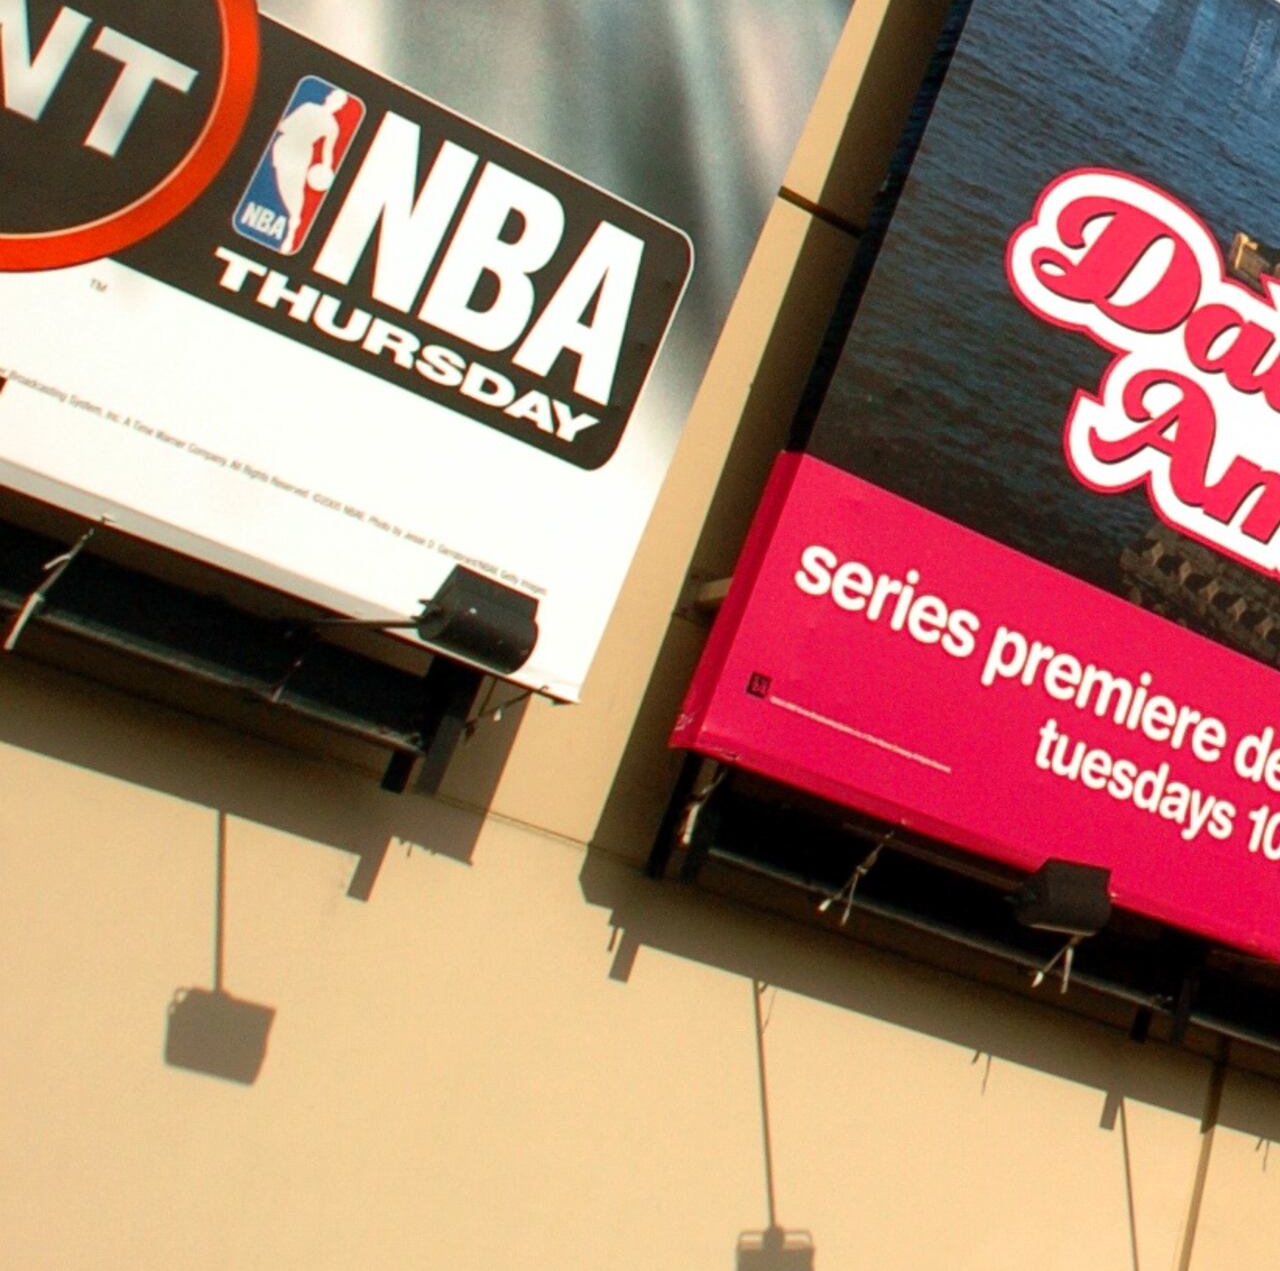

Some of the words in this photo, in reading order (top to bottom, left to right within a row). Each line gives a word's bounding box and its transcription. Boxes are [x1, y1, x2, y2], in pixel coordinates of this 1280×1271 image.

[241, 201, 287, 241] NBA
[313, 111, 645, 406] NBA
[214, 246, 599, 443] THURSDAY
[794, 544, 981, 658] series
[981, 626, 1227, 762] premiere
[1035, 718, 1236, 840] tuesdays
